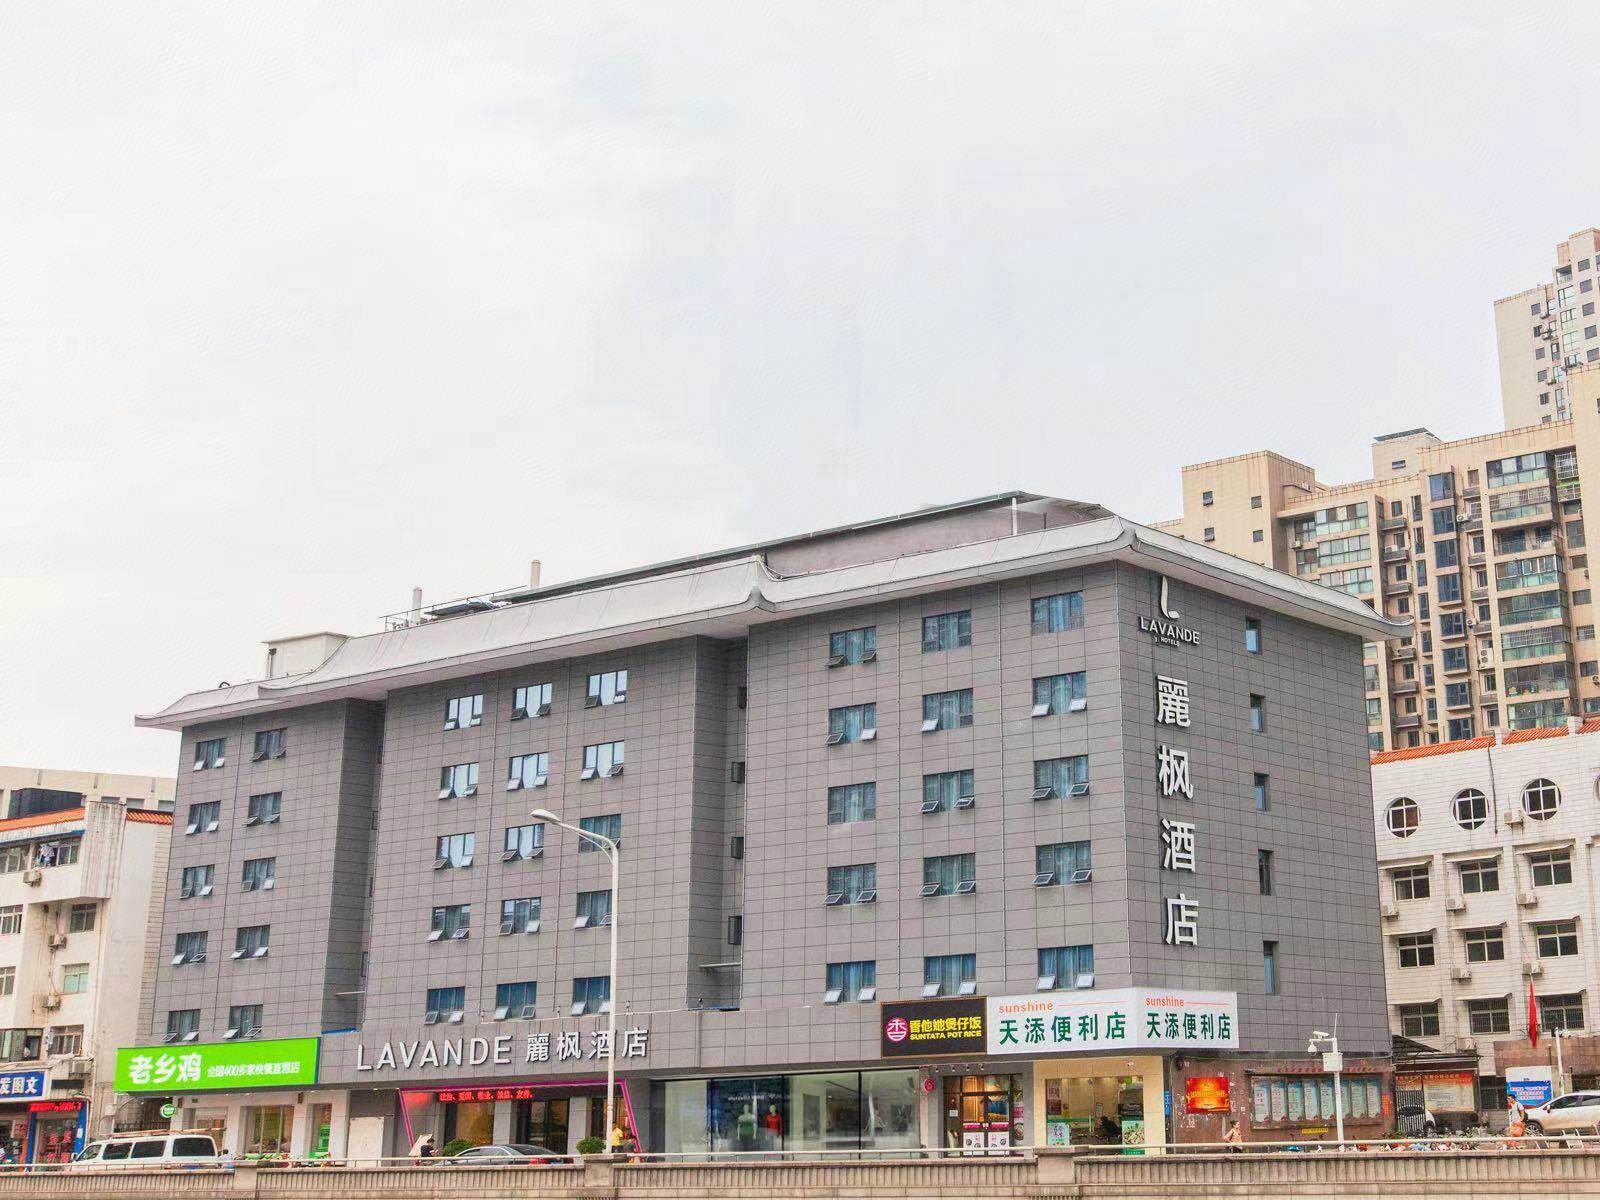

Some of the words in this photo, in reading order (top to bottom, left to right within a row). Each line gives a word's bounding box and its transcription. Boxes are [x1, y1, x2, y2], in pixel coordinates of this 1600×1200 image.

[1140, 616, 1200, 645] LAVANDE
[1156, 675, 1199, 946] 麗枫酒店
[998, 1000, 1054, 1014] sunshine
[1145, 992, 1184, 1007] sunshine
[910, 1033, 946, 1041] SUNTATA
[947, 1031, 963, 1039] POT
[964, 1030, 982, 1038] RICE
[998, 1012, 1127, 1046] 天添便利店
[1146, 1012, 1231, 1040] 天添便利店
[356, 1035, 512, 1071] LAVANDE
[526, 1027, 649, 1063] 麗枫酒店
[128, 1053, 202, 1085] 老乡鸡
